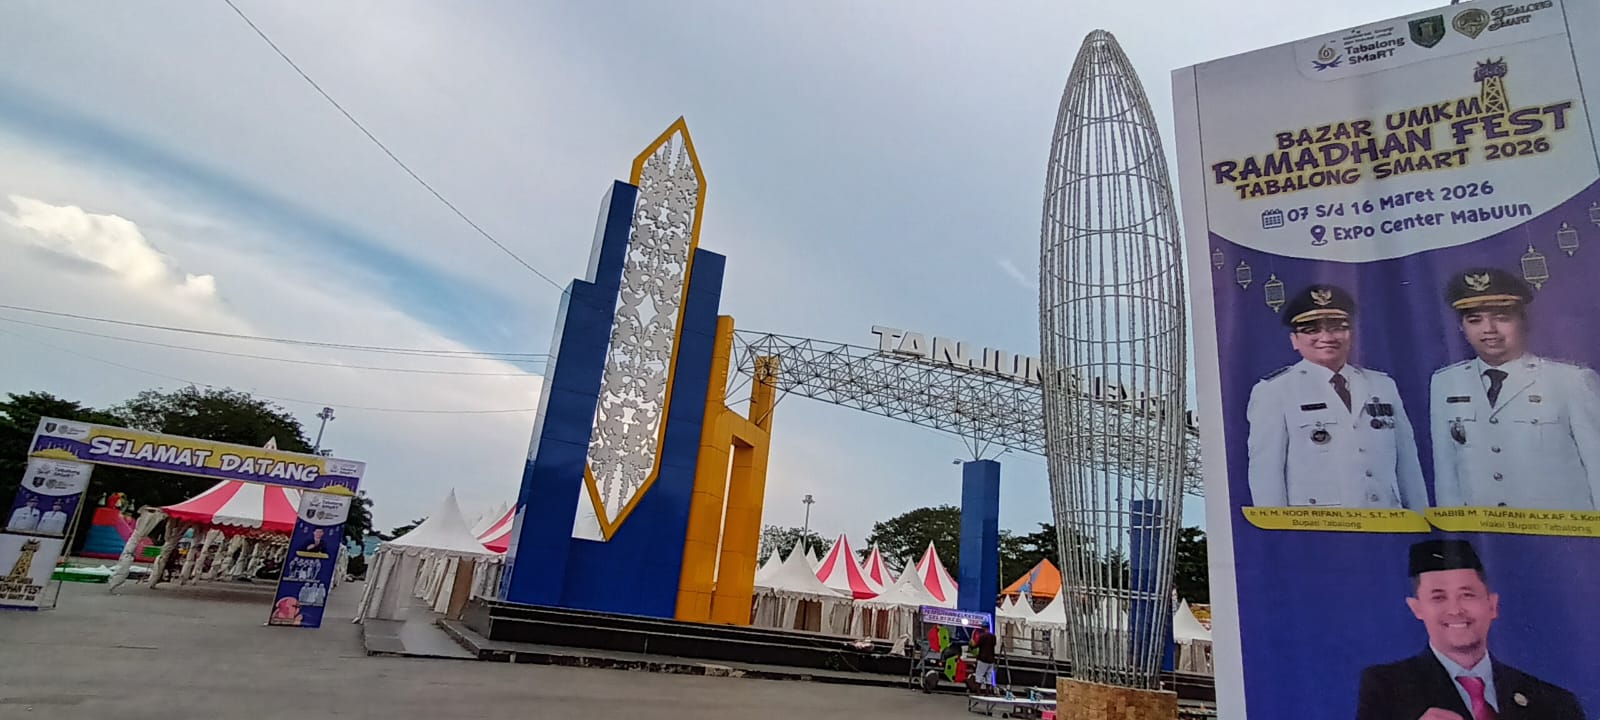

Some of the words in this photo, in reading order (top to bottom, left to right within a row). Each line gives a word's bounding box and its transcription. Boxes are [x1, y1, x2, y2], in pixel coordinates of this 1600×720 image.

[1344, 37, 1406, 55] Tabalong
[1348, 48, 1396, 65] SMaRT
[1212, 127, 1432, 184] RAMADHAN
[1452, 101, 1572, 145] FEST
[1276, 120, 1372, 150] BAZAR
[1386, 97, 1482, 131] UMKM
[1236, 168, 1361, 199] TABALONG
[1373, 147, 1470, 179] SMART
[1485, 137, 1550, 161] 2026
[1287, 207, 1309, 222] 07
[1351, 200, 1374, 215] 16
[1380, 189, 1435, 211] Maret
[1440, 181, 1494, 201] 2026
[1380, 213, 1445, 234] Center
[89, 436, 212, 468] SELAMAT
[220, 454, 320, 482] DATANG
[1434, 510, 1465, 518] HABIB
[1482, 510, 1526, 519] TAUFANI
